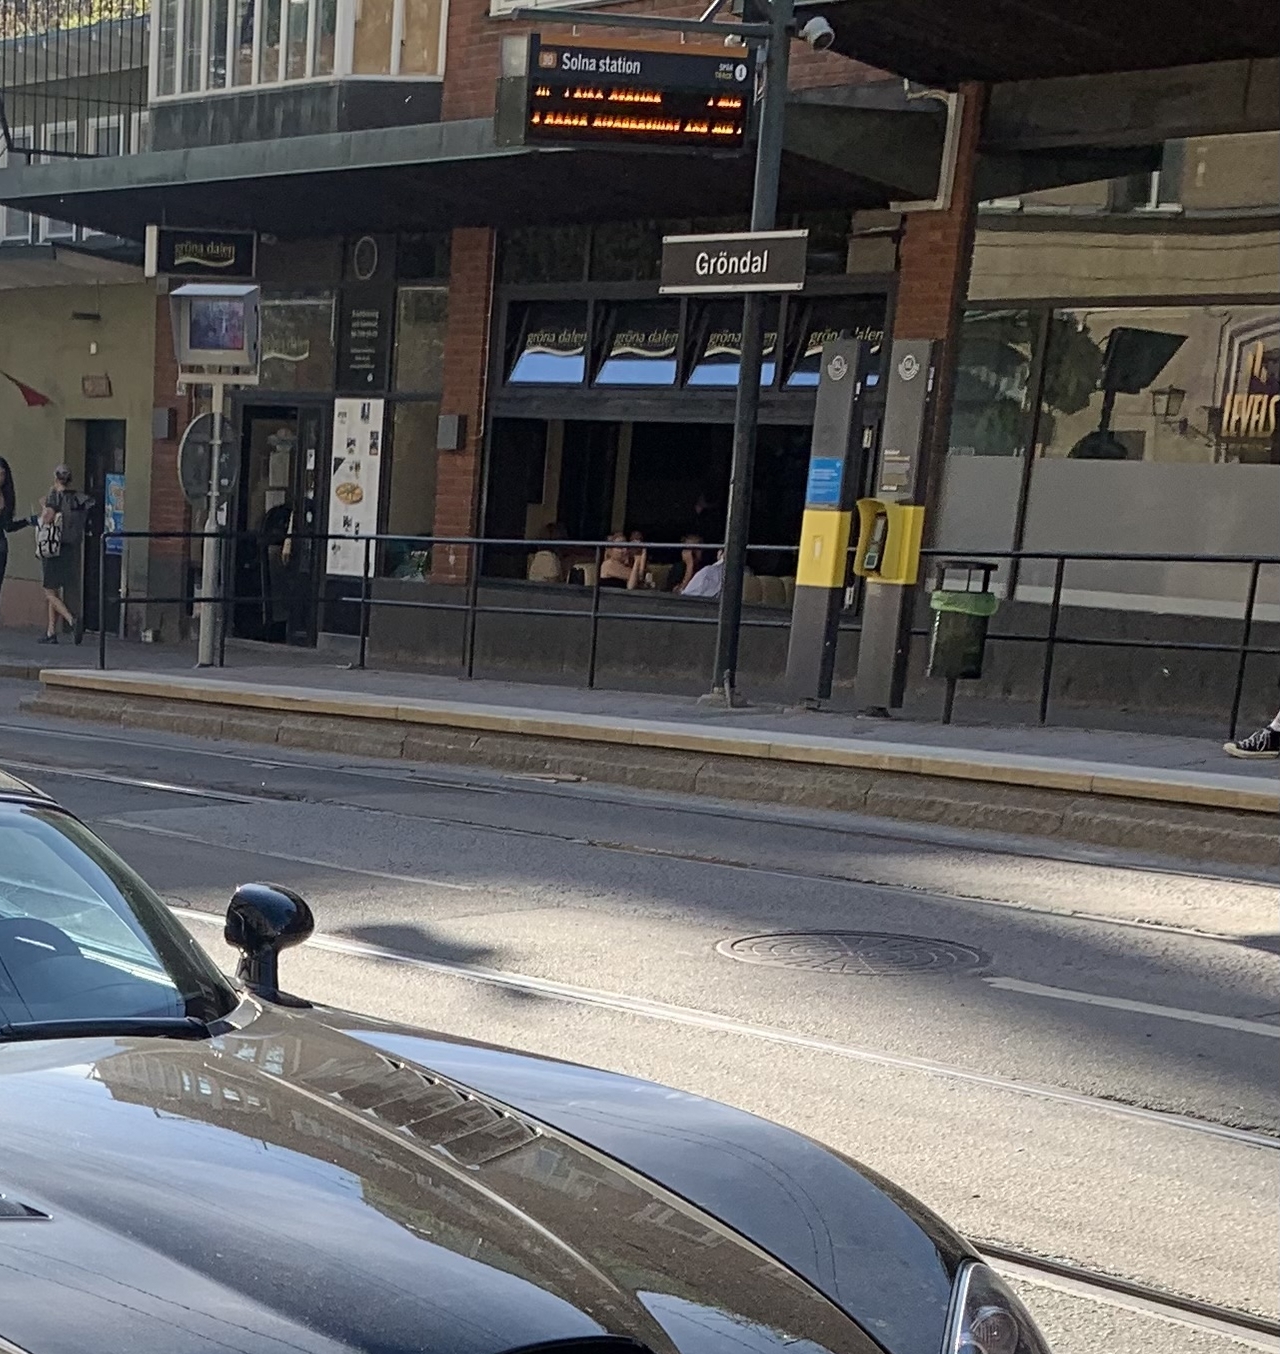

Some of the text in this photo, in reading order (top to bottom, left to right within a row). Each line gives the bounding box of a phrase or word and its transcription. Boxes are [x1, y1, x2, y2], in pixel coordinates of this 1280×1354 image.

[562, 52, 596, 71] Solna
[599, 56, 641, 75] station
[695, 249, 769, 276] Gröndal
[526, 328, 588, 346] gröna dalen
[614, 329, 679, 347] gröna dalen
[807, 326, 839, 346] grön
